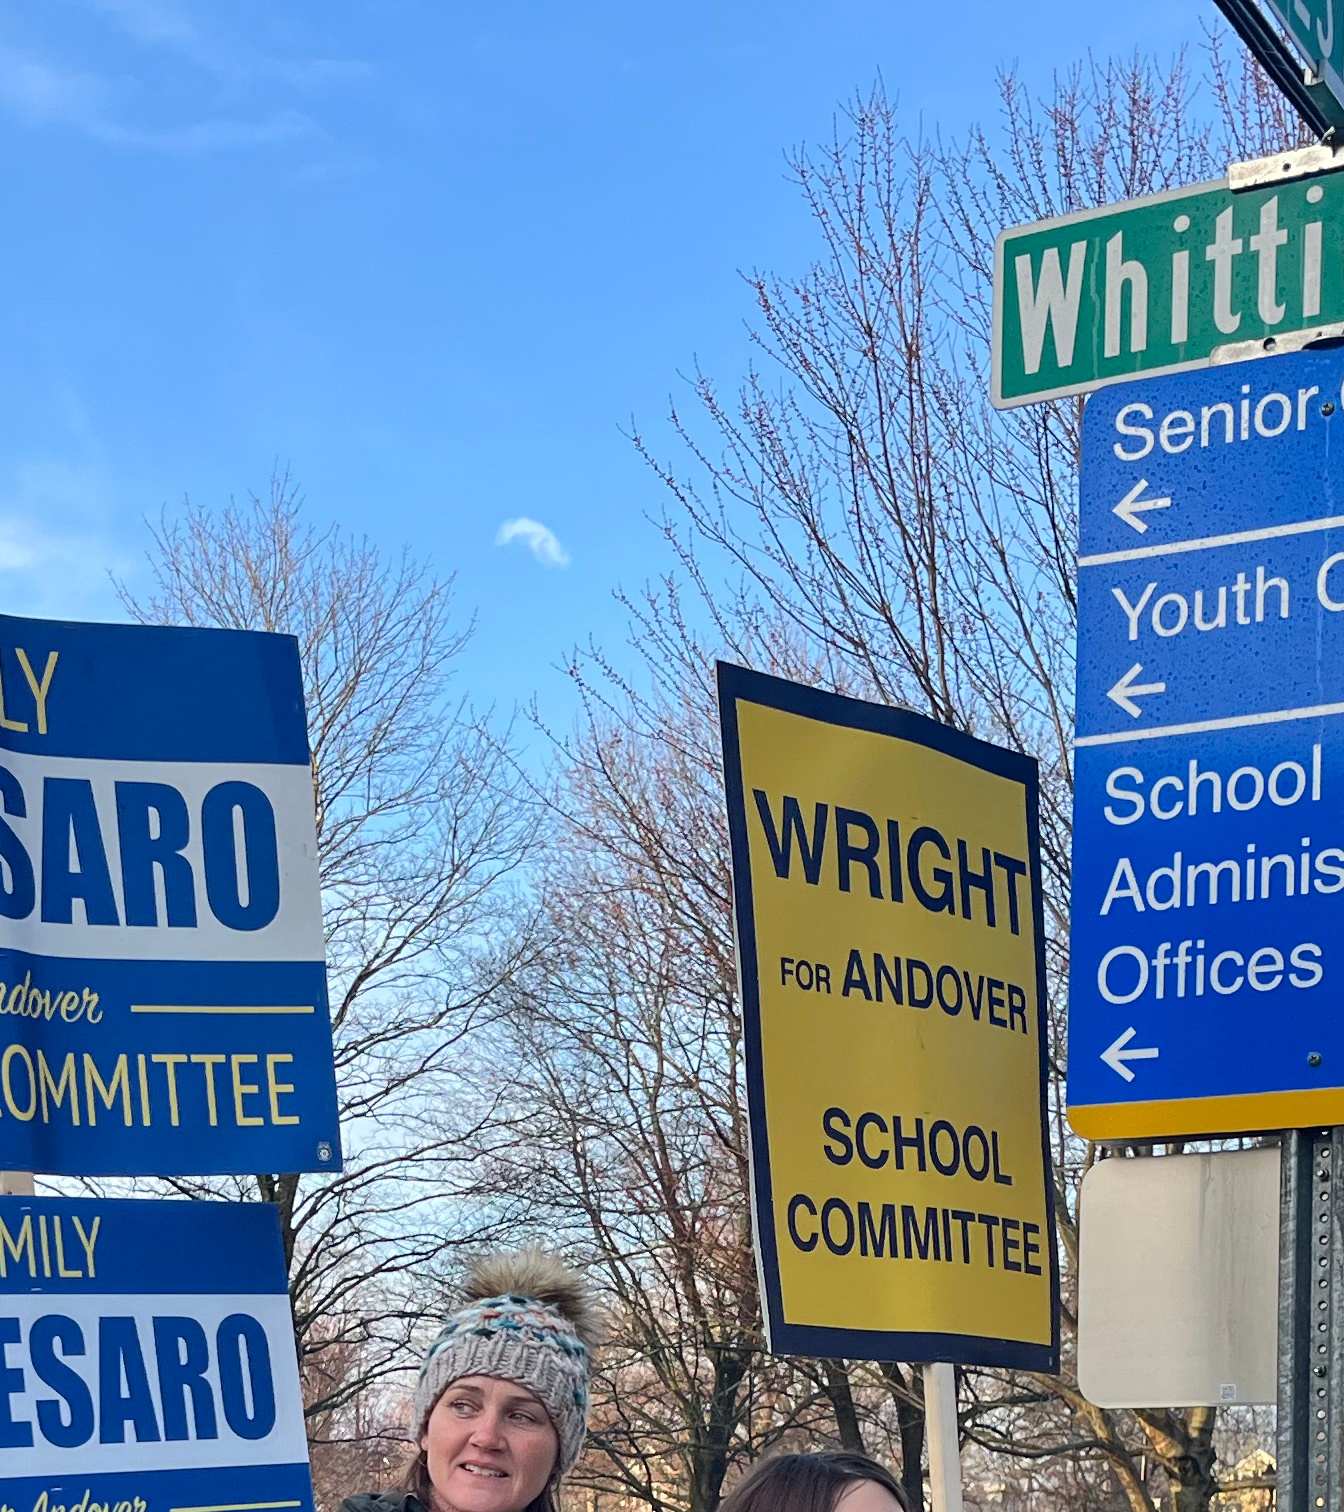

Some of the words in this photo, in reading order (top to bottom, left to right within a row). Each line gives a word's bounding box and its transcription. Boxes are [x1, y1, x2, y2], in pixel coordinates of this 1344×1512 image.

[1113, 384, 1320, 462] Senior
[1111, 565, 1290, 641] Youth
[1102, 743, 1323, 826] School
[753, 788, 1027, 936] WRIGHT
[780, 956, 832, 996] FOR
[841, 948, 1029, 1035] ANDOVER
[1096, 940, 1324, 1005] Offices
[822, 1106, 1013, 1187] SCHOOL
[787, 1193, 1043, 1277] COMMITTEE
